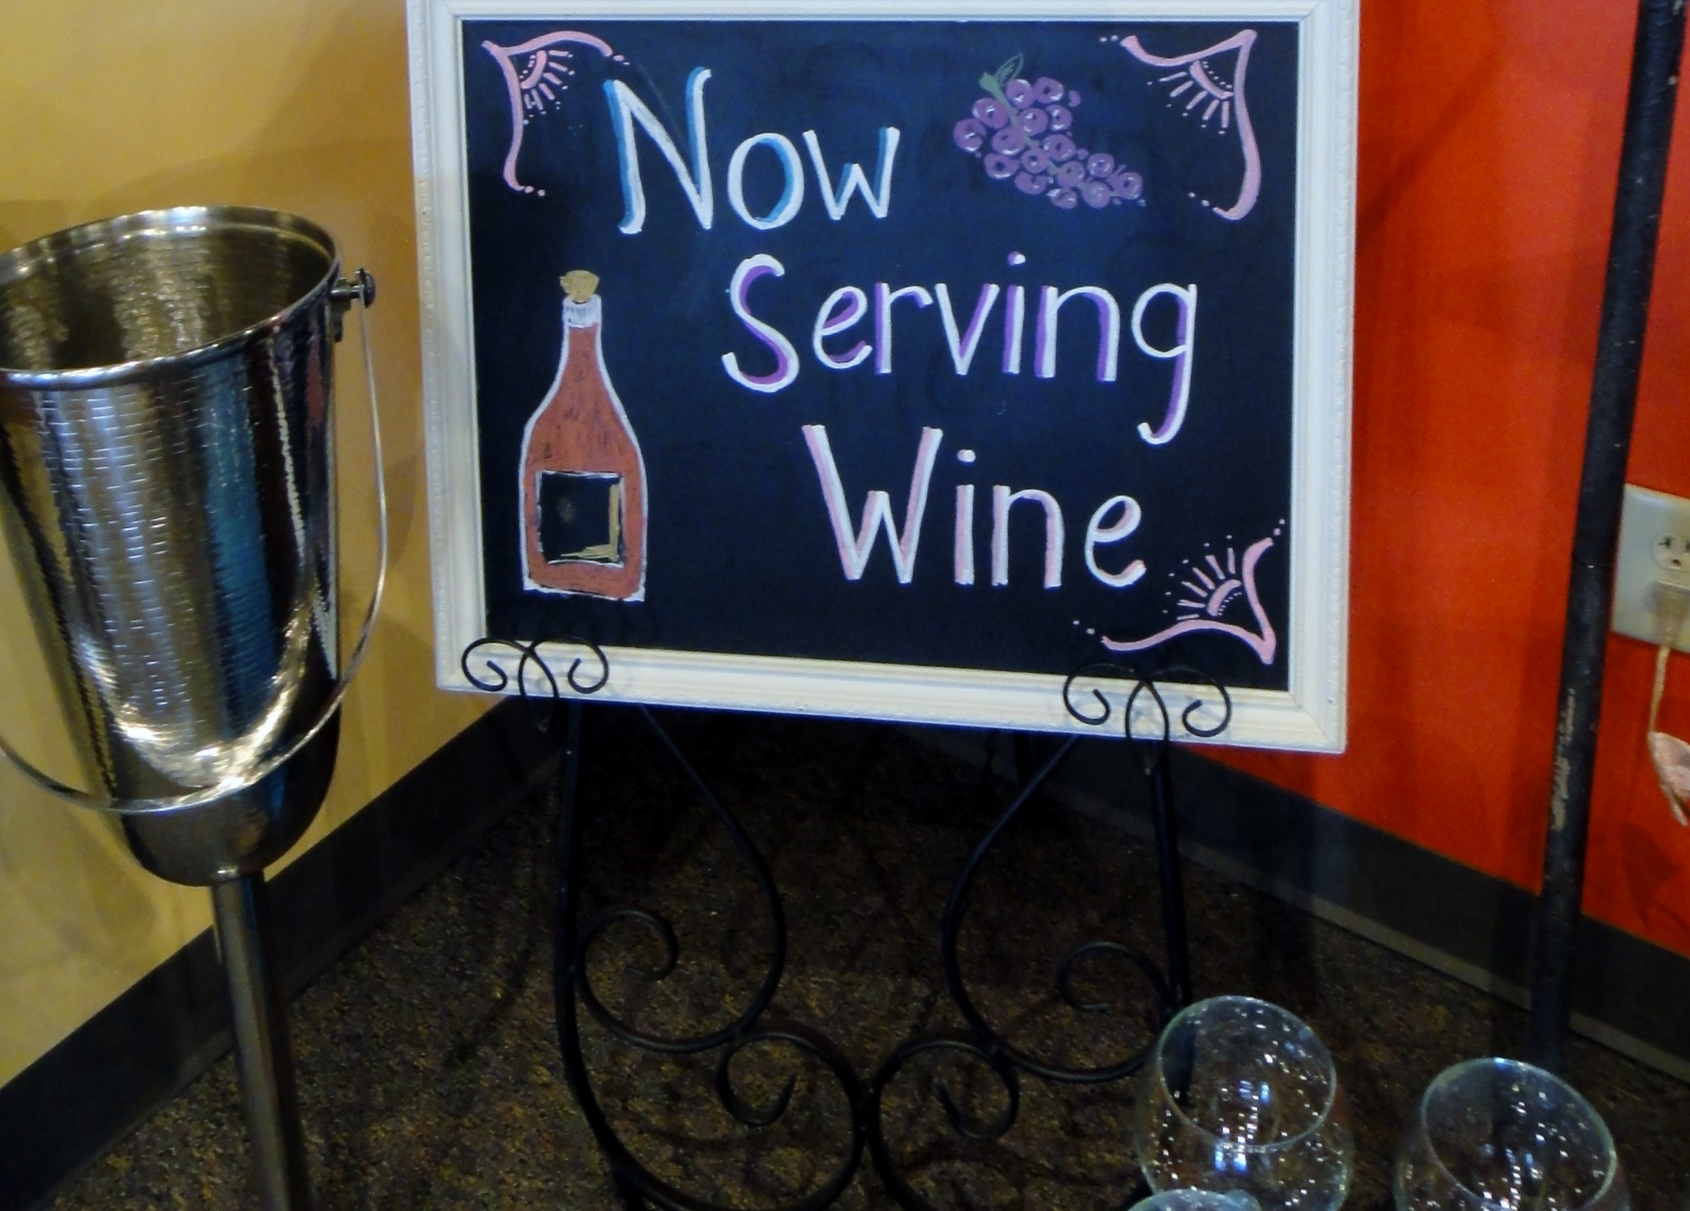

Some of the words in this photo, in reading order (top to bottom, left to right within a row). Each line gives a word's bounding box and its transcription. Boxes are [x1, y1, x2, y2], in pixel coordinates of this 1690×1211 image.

[603, 67, 901, 235] Now
[722, 253, 1198, 445] Serving
[802, 424, 1147, 588] Wine
